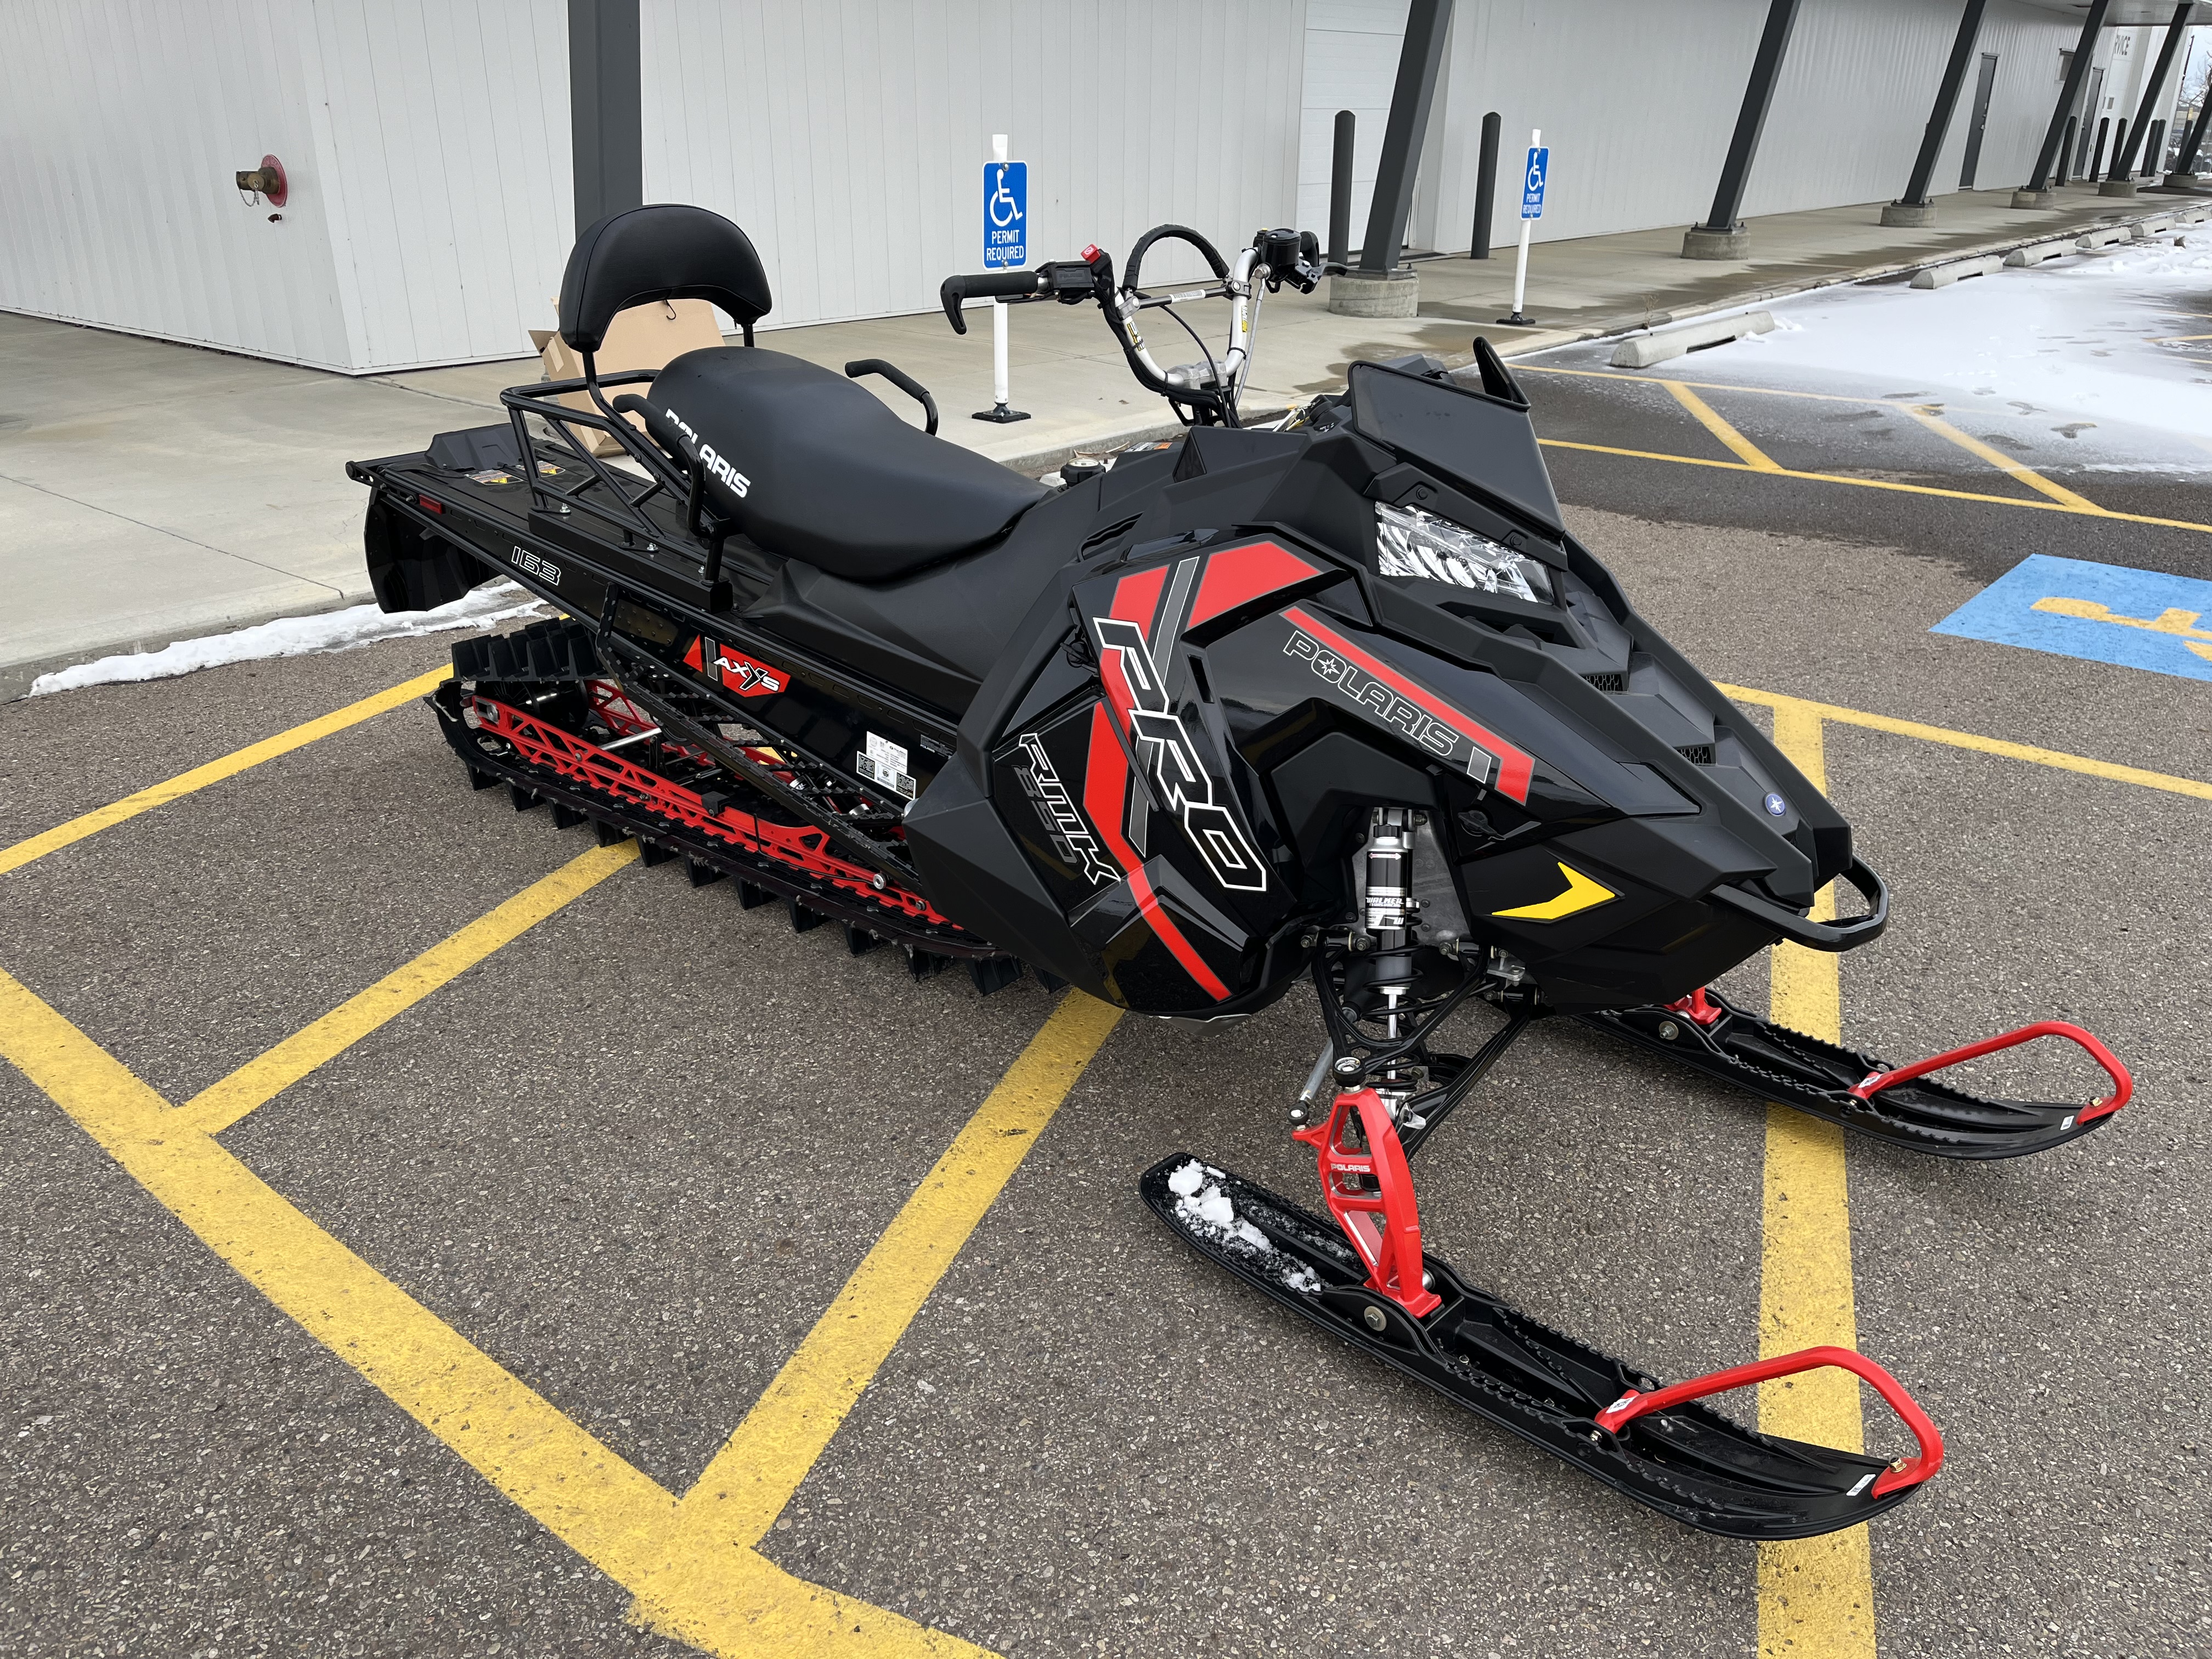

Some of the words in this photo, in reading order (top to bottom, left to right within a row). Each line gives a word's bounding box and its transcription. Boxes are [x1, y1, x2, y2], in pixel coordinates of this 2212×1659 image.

[1522, 204, 1542, 214] REQUIRED
[1526, 193, 1541, 203] PERMIT
[986, 245, 1024, 261] REQUIRED
[991, 229, 1020, 245] PERMIT
[665, 408, 751, 498] ARIS
[511, 545, 561, 586] 163
[713, 657, 780, 692] AXYS
[1283, 630, 1459, 756] POLARIS
[1093, 617, 1267, 891] PRO
[1012, 765, 1079, 864] 850
[1018, 732, 1121, 885] RMK
[1330, 1163, 1370, 1172] POLARIS
